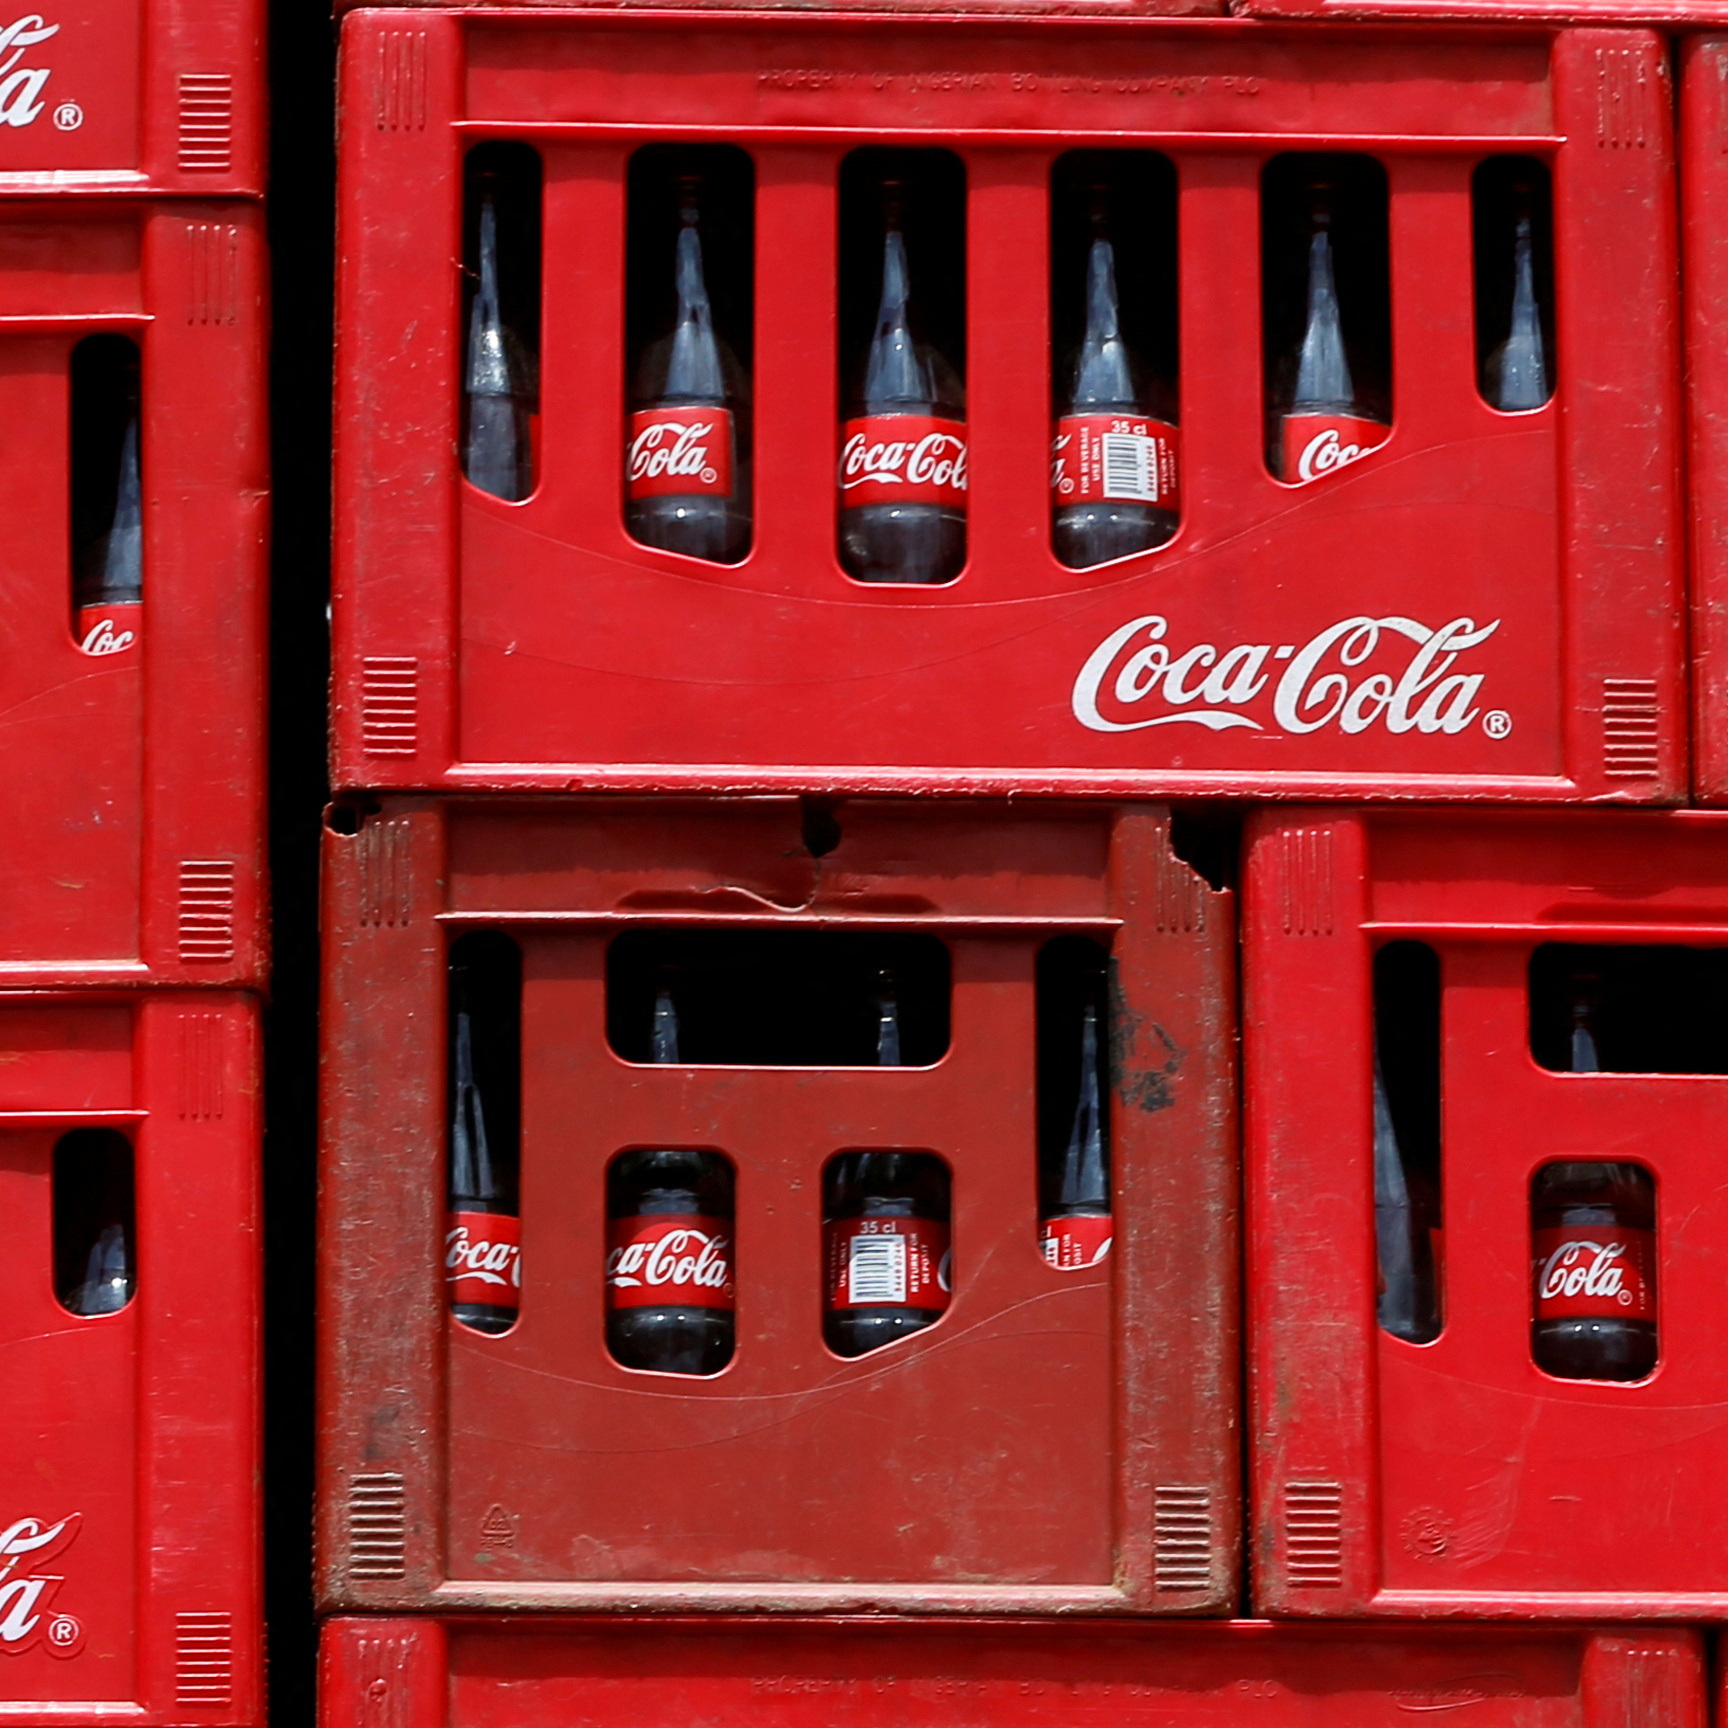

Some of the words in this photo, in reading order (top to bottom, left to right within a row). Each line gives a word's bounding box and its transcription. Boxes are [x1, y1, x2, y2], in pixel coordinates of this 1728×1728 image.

[1111, 420, 1131, 433] 35
[1133, 423, 1147, 436] cl
[1080, 426, 1090, 474] BEVERAGE
[1091, 437, 1100, 462] ONLY
[1092, 463, 1100, 482] USE
[1080, 476, 1090, 495] FOR
[1072, 614, 1502, 735] Coca-Cola
[859, 1221, 879, 1235] 35
[882, 1221, 897, 1234] cl
[910, 1232, 919, 1252] FOR
[909, 1254, 919, 1293] RETURN
[921, 1243, 930, 1285] DEPOSIT
